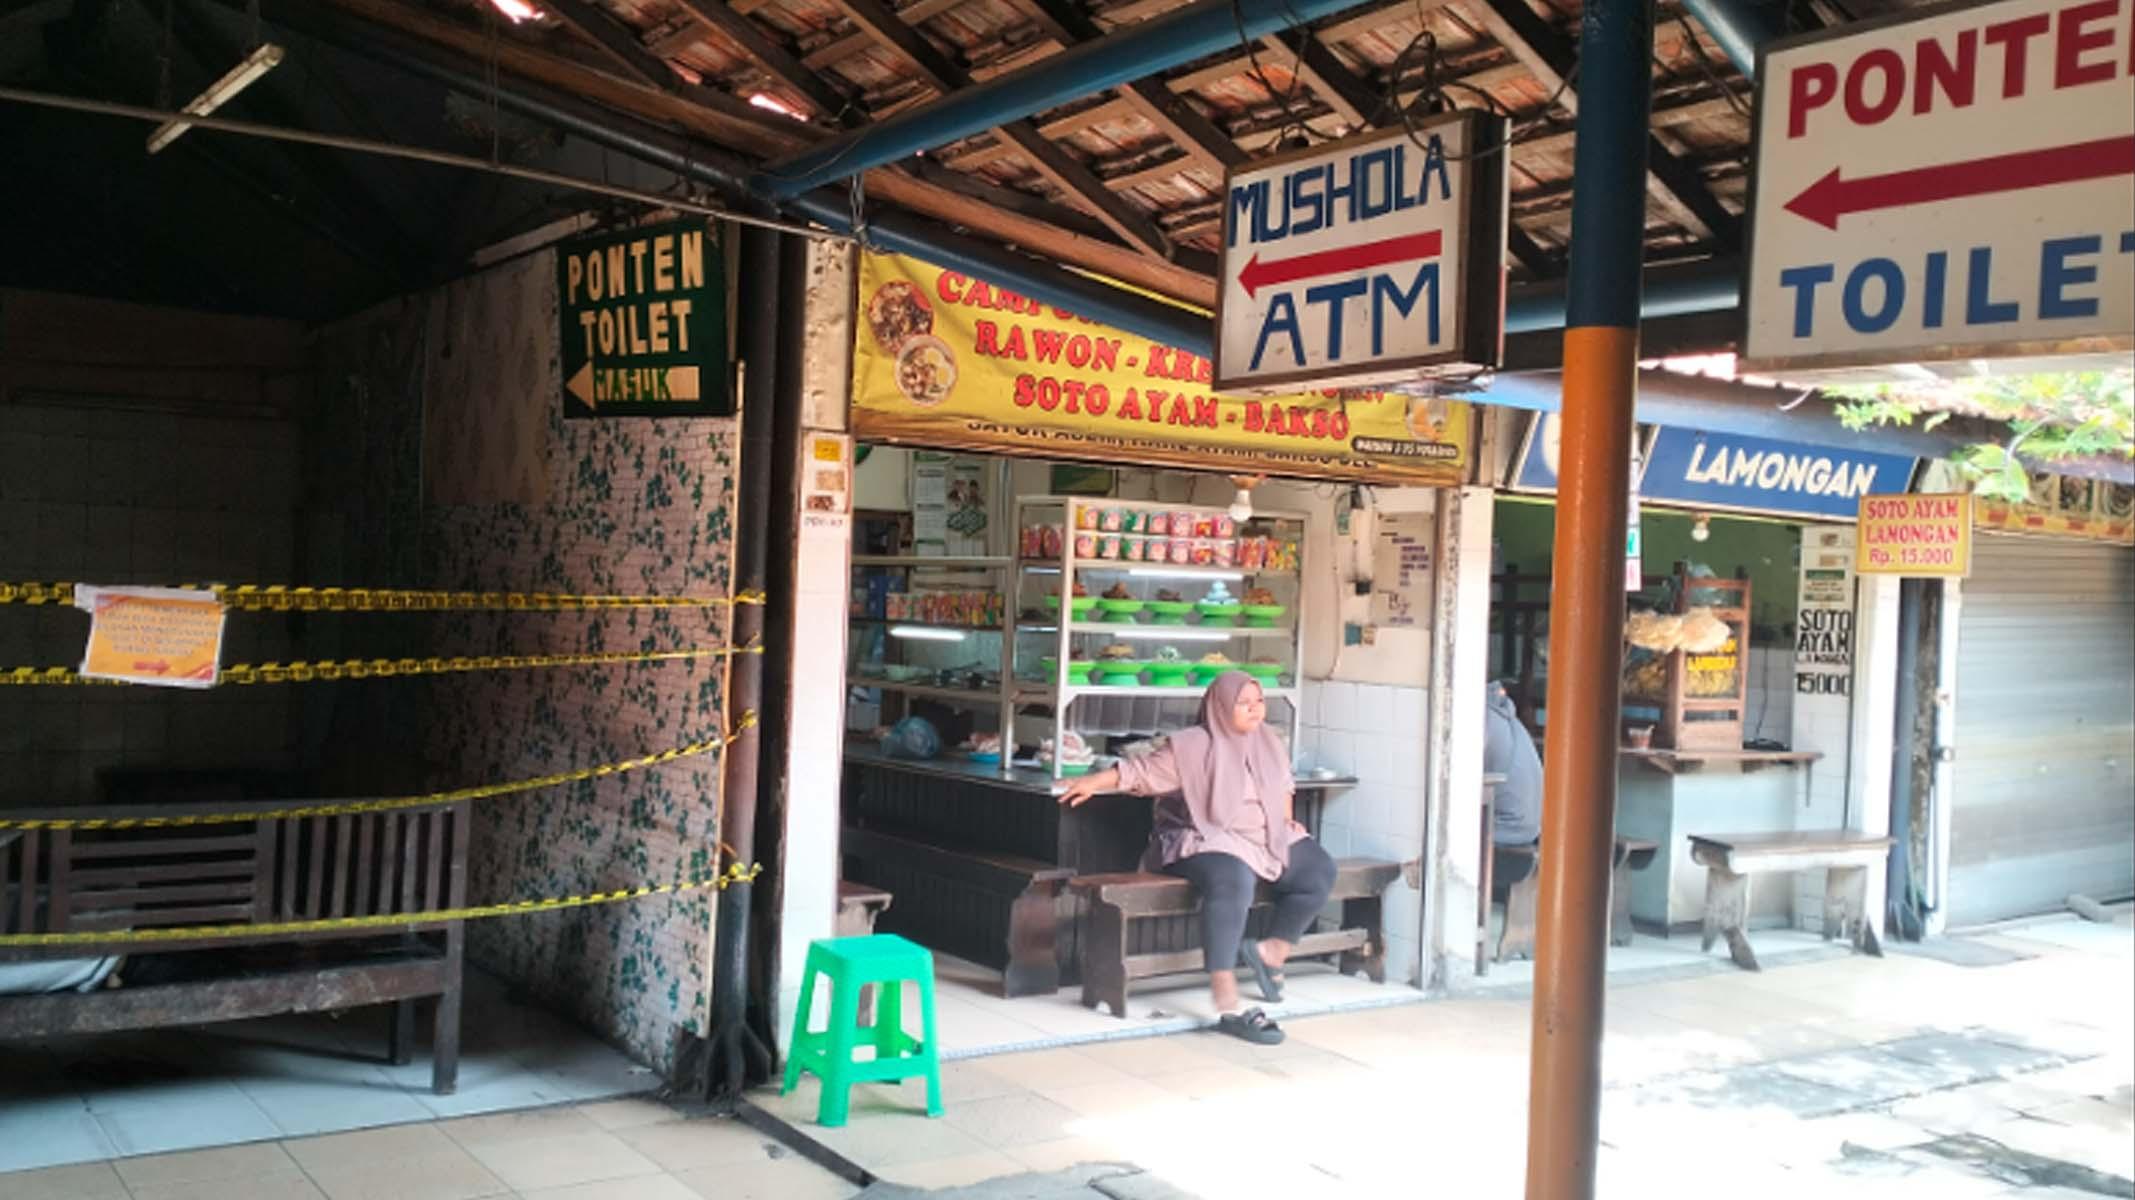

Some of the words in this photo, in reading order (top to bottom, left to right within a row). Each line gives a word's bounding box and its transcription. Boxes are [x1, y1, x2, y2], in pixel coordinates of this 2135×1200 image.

[1788, 0, 2135, 139] PONTE
[1229, 133, 1450, 247] MUSHOLA
[567, 230, 703, 304] PONTEN
[937, 270, 1104, 326] CAM
[1250, 262, 1440, 371] ATM
[579, 300, 691, 356] TOILET
[974, 319, 1122, 372] RAWON
[1144, 344, 1213, 384] KRE
[1013, 373, 1110, 415] SOTO
[1116, 387, 1220, 430] AYAM
[1242, 400, 1349, 440] BAKSO
[1685, 442, 1878, 498] LAMONGAN
[1865, 524, 1959, 545] LAMONGAN
[1867, 500, 1909, 520] SOTO
[1914, 498, 1958, 520] AYAM
[1870, 546, 1896, 567] Rp.
[1900, 546, 1953, 565] 15.000
[1798, 632, 1850, 653] AYAM
[1799, 608, 1852, 631] SOTO
[1796, 671, 1851, 696] 15000
